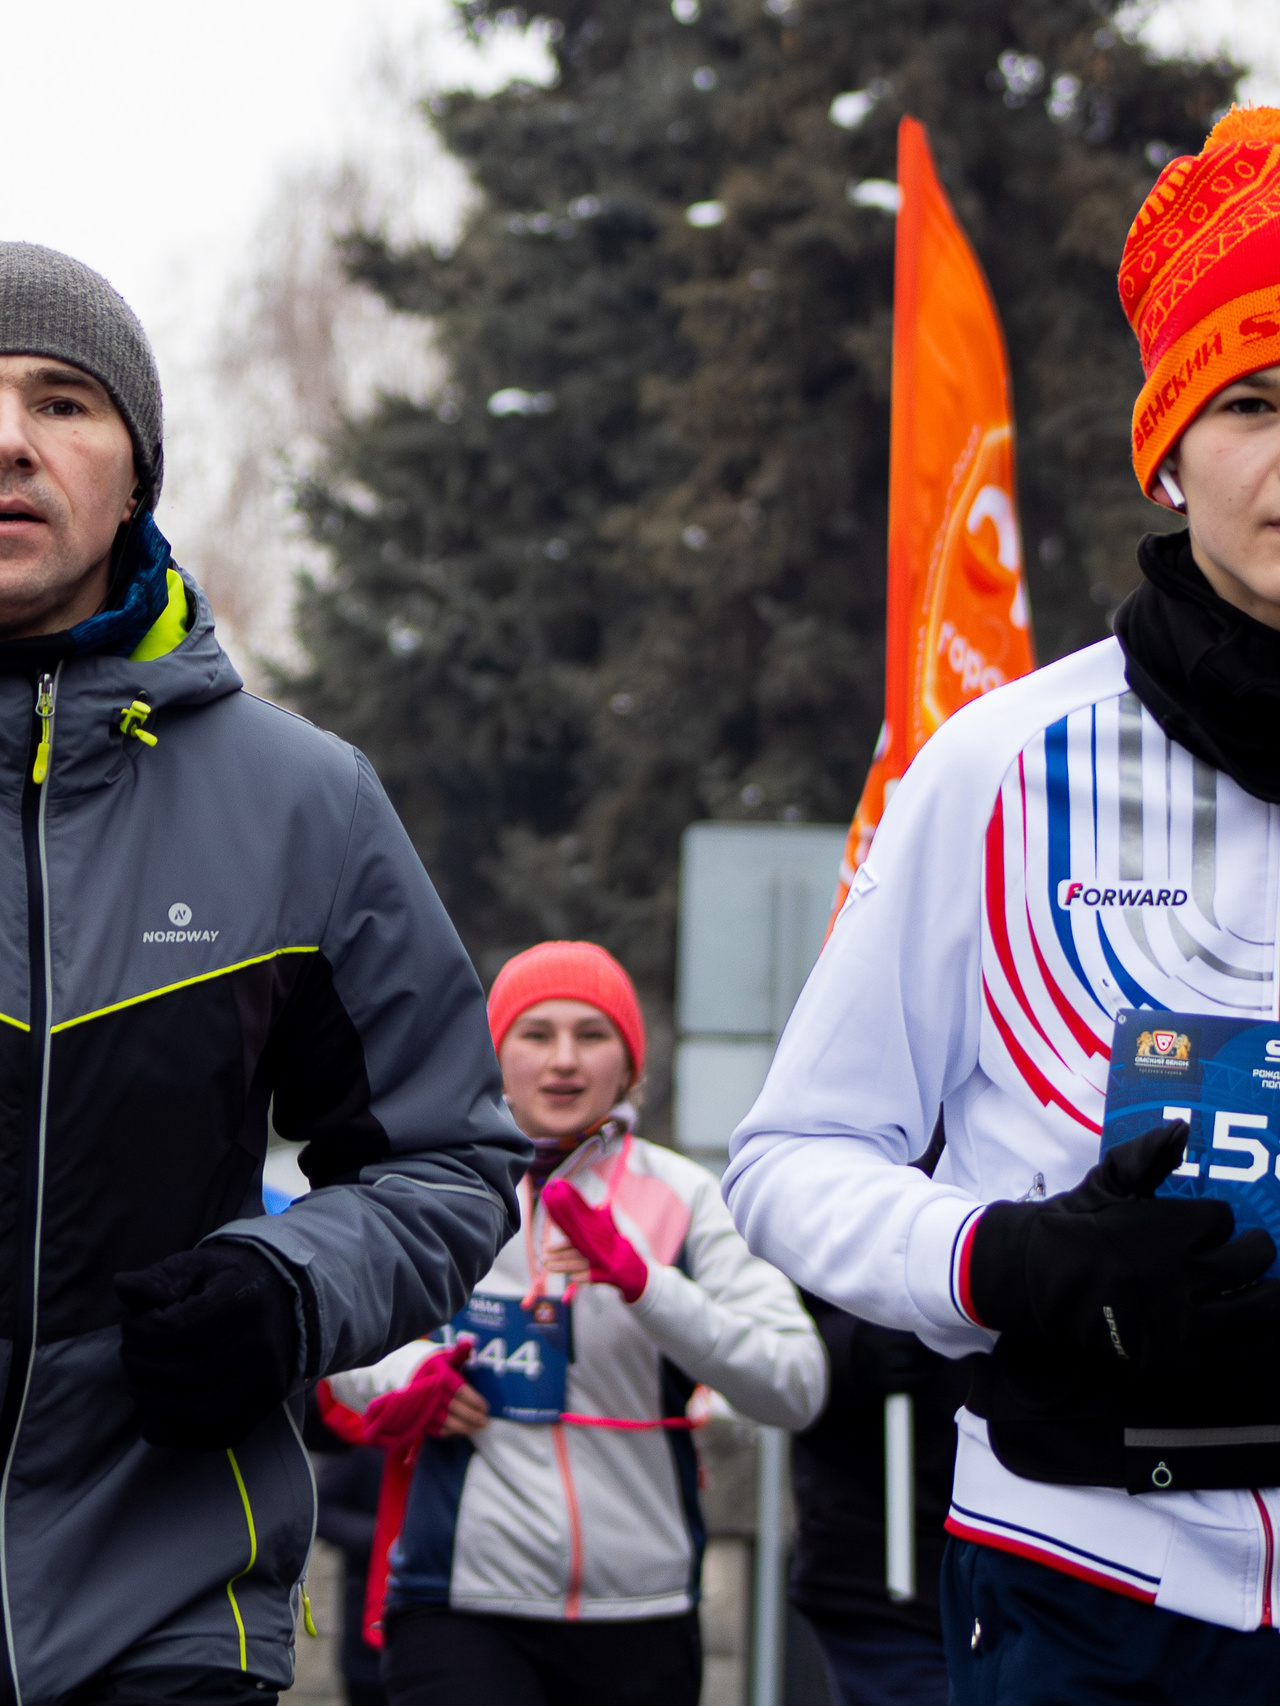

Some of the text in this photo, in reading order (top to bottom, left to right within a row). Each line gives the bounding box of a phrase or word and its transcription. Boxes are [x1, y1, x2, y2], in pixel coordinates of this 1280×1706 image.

[1064, 882, 1188, 907] FORWARD
[142, 930, 220, 943] NORDWAY
[1163, 1106, 1280, 1183] 15
